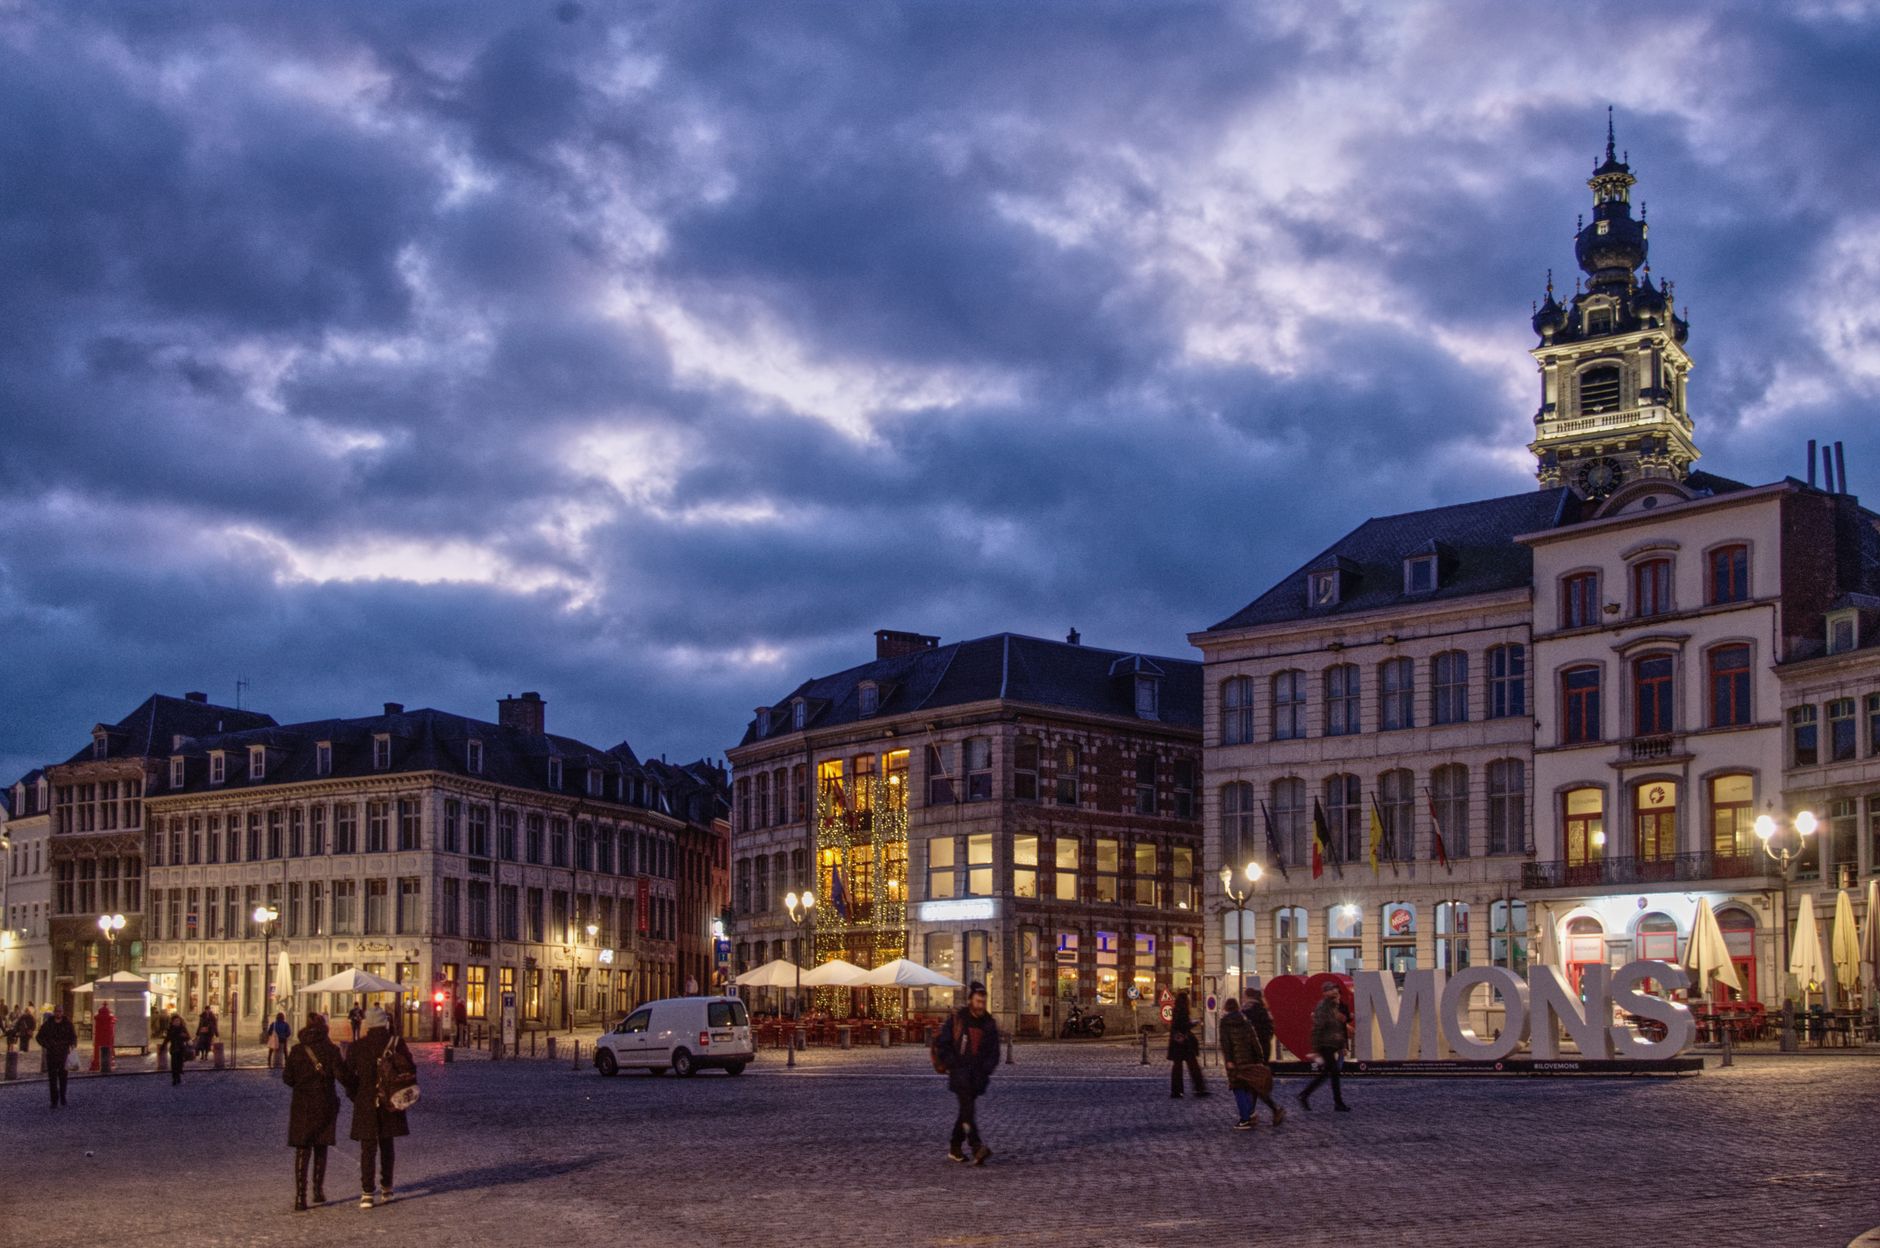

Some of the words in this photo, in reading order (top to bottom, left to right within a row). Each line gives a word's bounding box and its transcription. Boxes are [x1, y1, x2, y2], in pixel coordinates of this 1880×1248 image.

[1164, 1008, 1173, 1018] 30
[1354, 960, 1695, 1061] MONS
[1533, 1062, 1580, 1070] #ILOVEMONS
